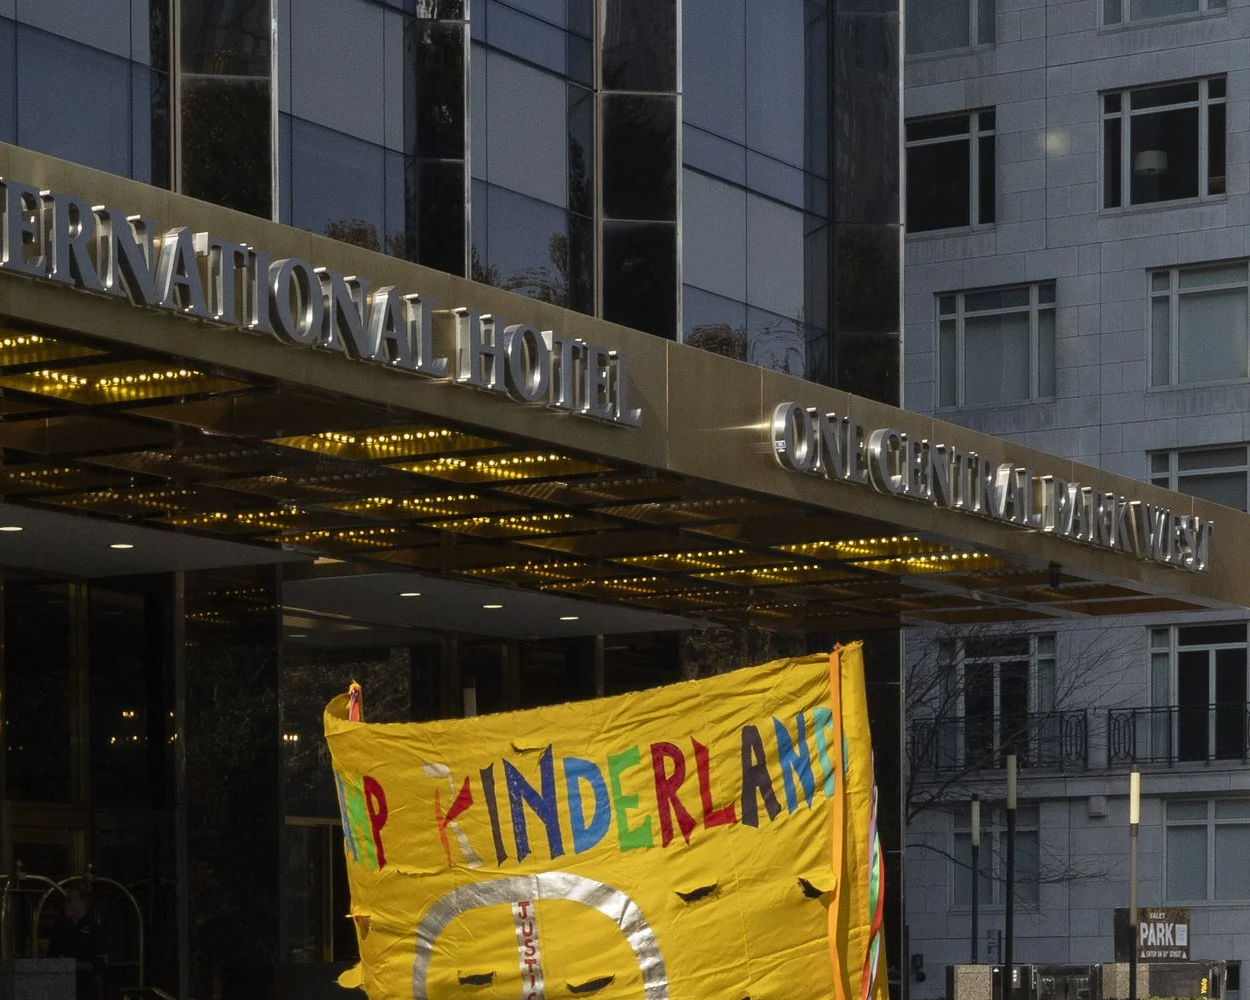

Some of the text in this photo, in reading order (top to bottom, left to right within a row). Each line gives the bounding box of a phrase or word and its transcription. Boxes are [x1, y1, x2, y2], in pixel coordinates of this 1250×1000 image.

[453, 306, 643, 428] HOTEL
[771, 402, 1214, 574] ONE CENTRAL PARK WEST
[1140, 922, 1175, 946] PARK
